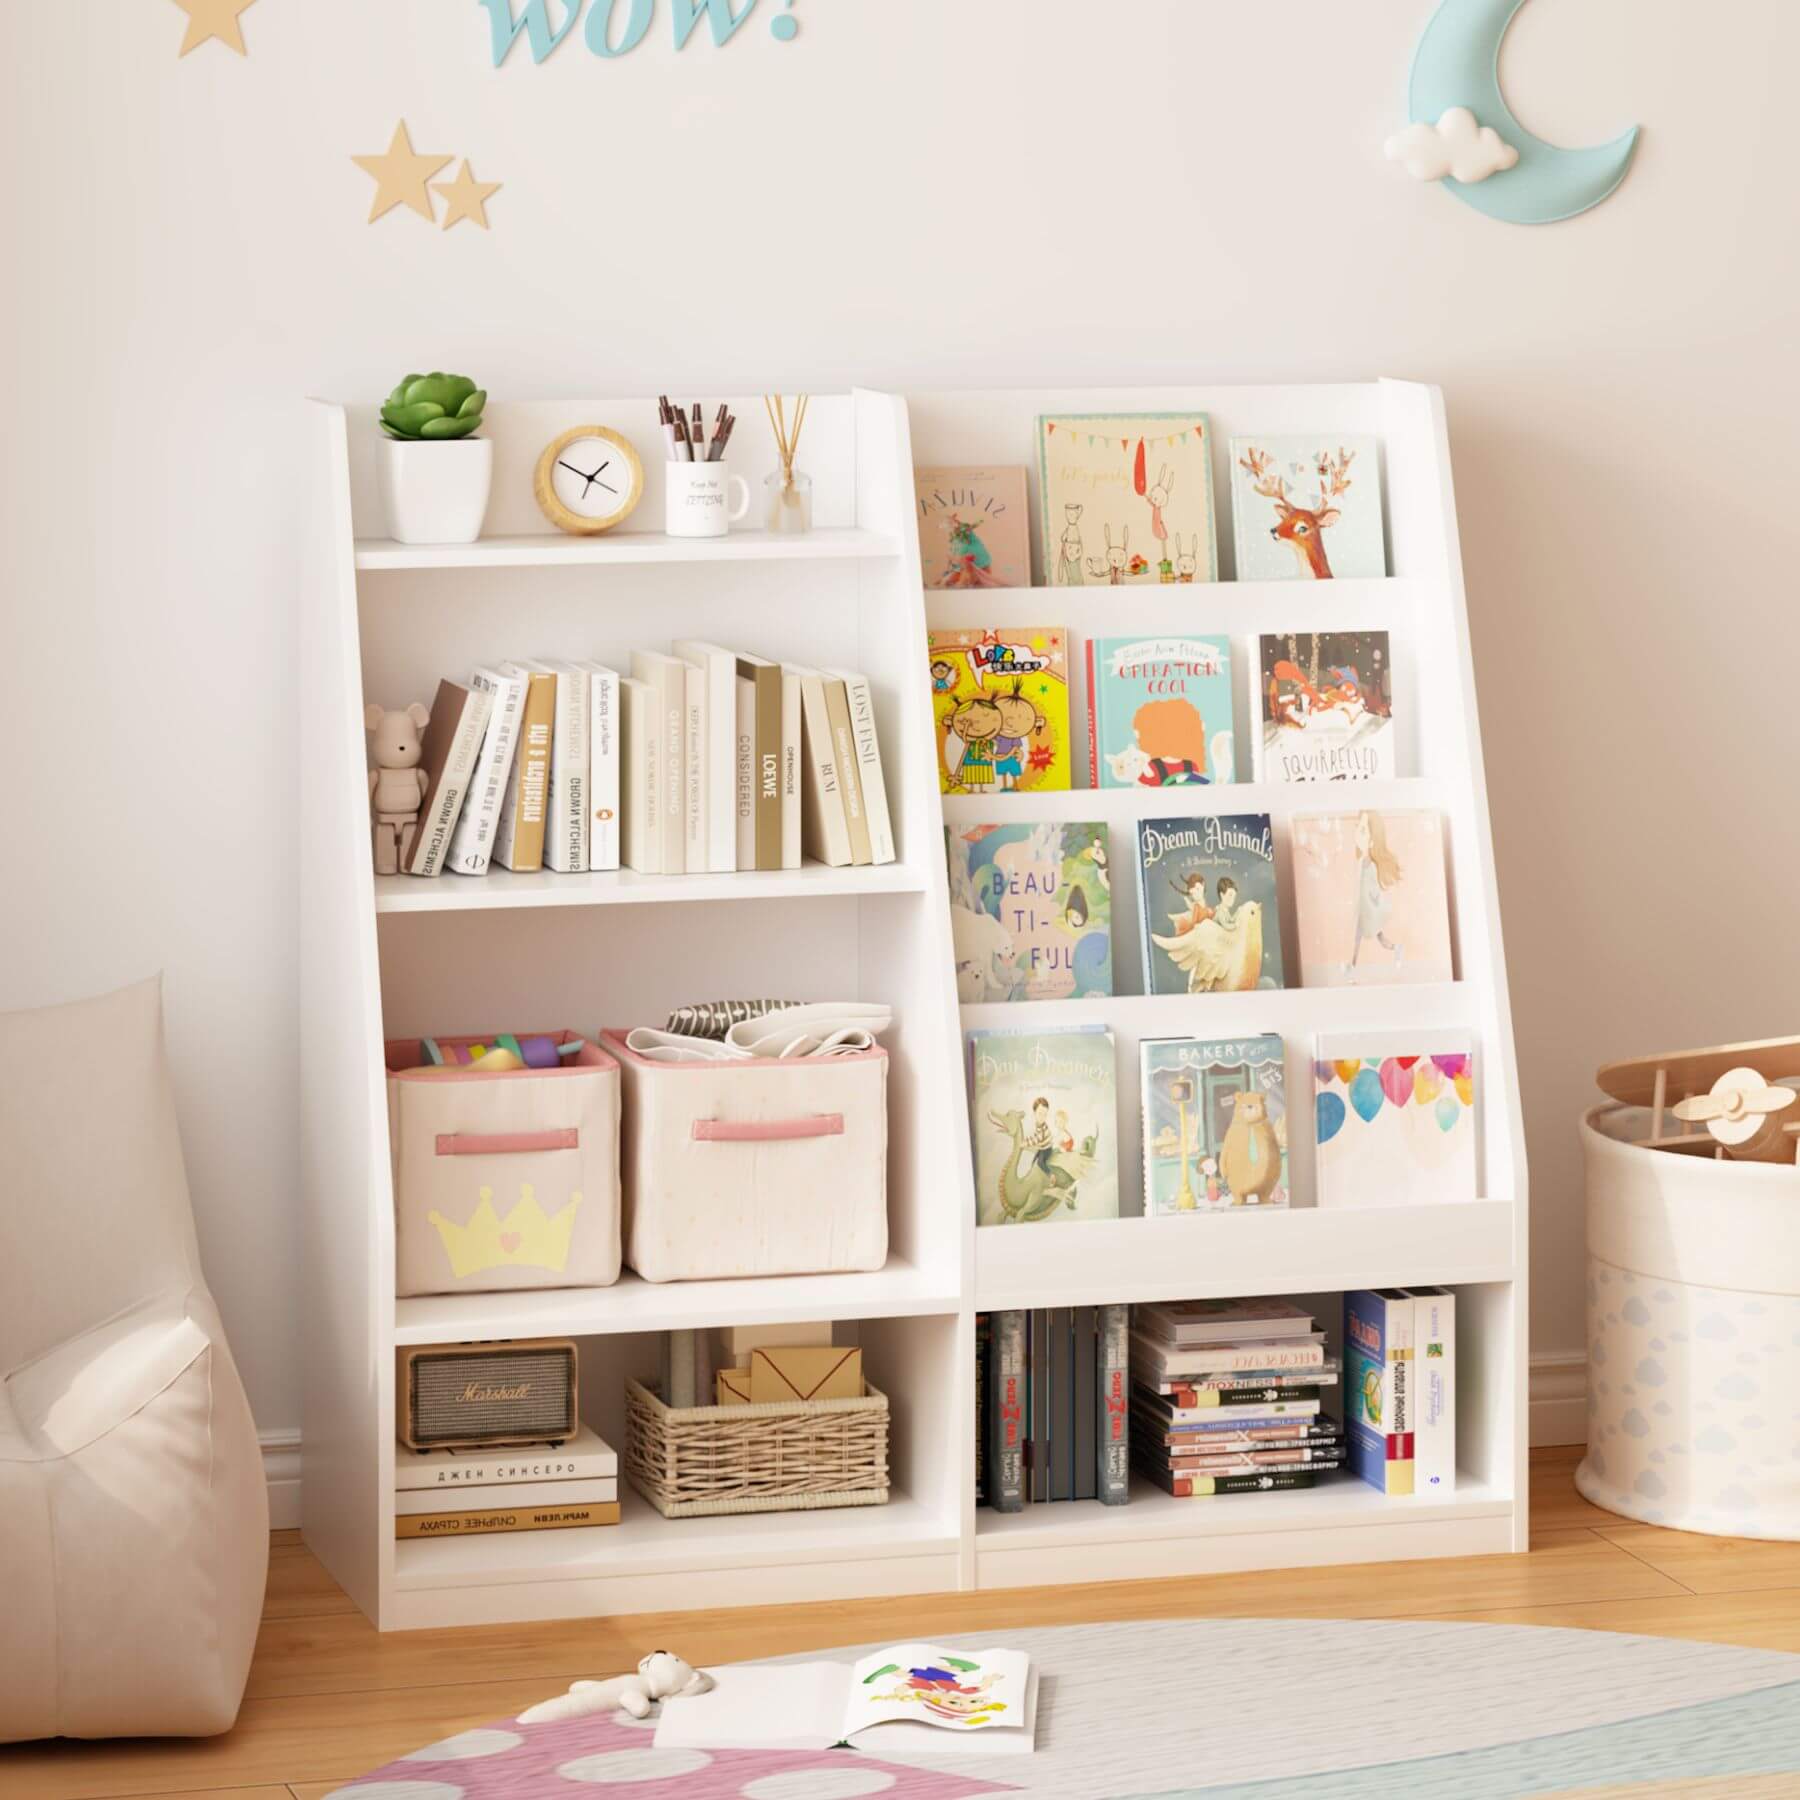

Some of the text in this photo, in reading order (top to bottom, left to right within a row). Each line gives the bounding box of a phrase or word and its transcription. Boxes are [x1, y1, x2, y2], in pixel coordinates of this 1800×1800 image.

[1119, 661, 1217, 679] OPERATION
[1148, 679, 1186, 694] COOL
[851, 683, 877, 765] LOST FISH
[669, 709, 680, 816] GRAND OPENING
[739, 734, 751, 818] CONSIDERED
[762, 754, 777, 799] LOEWE
[786, 746, 795, 796] OPENHOUSE
[1282, 747, 1379, 782] SQUIRRELLED
[820, 763, 837, 793] RUM
[1142, 816, 1273, 868] Dream Animals
[1013, 909, 1049, 933] TI-
[1031, 946, 1073, 970] FUL
[1178, 1043, 1246, 1061] BAKERY
[455, 1381, 532, 1402] Marshall
[438, 1463, 576, 1482] ДЖЕН СИНСЕРО
